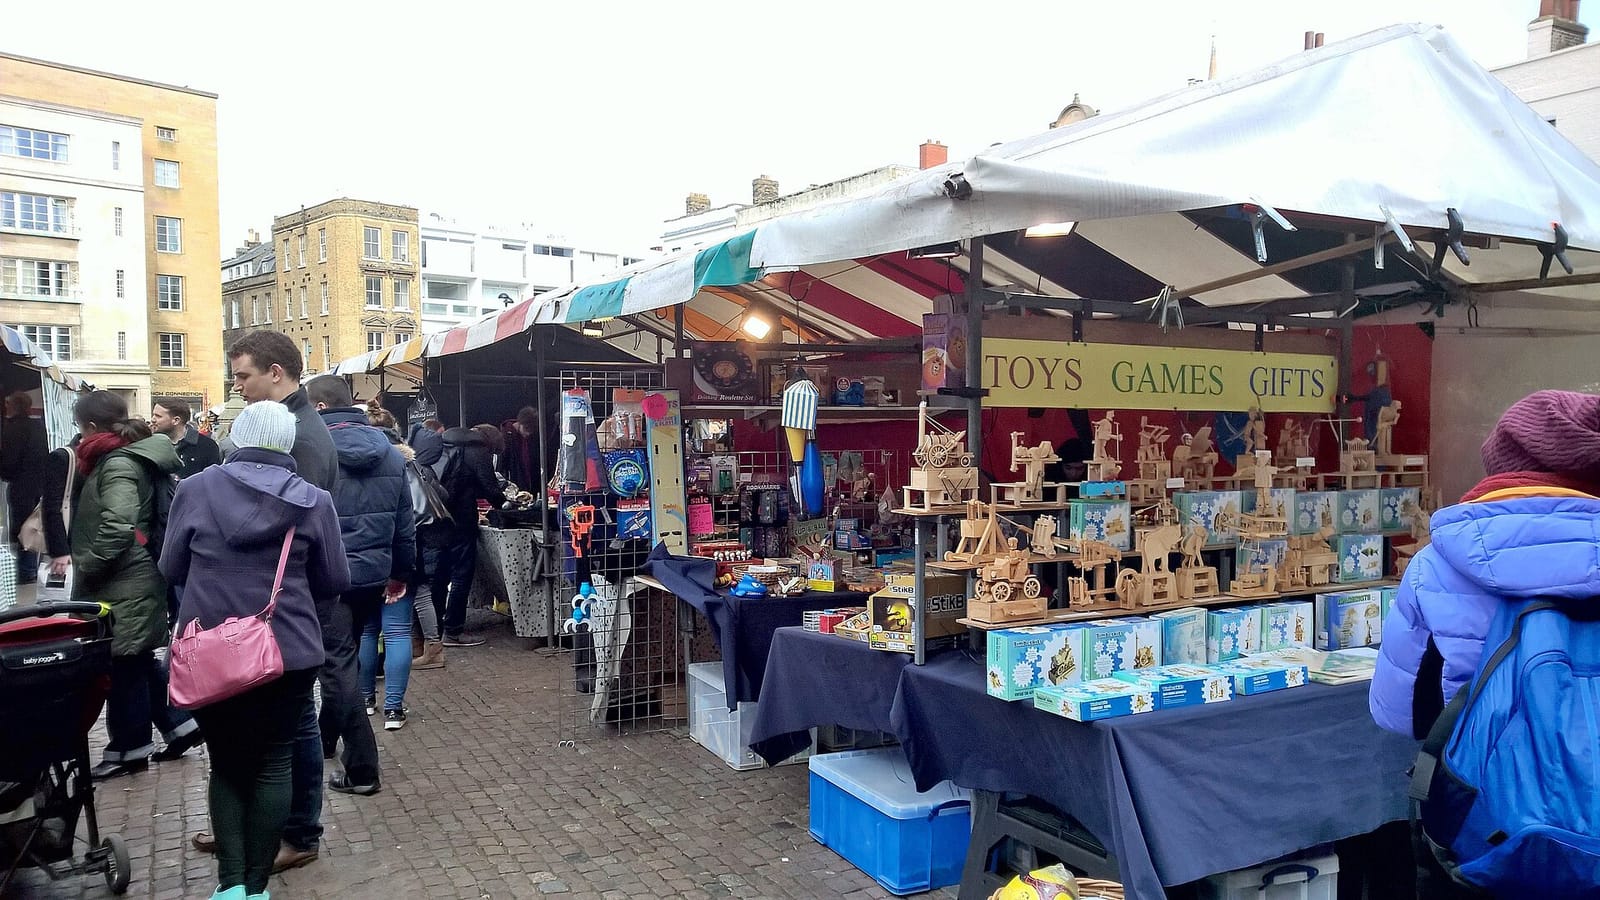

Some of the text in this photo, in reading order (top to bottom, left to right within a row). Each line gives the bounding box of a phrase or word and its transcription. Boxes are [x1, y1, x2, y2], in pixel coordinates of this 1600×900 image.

[984, 355, 1325, 398] TOYS GAMES GIFTS
[892, 586, 914, 594] StikB
[930, 594, 964, 612] StikB
[23, 656, 56, 665] baby jogger
